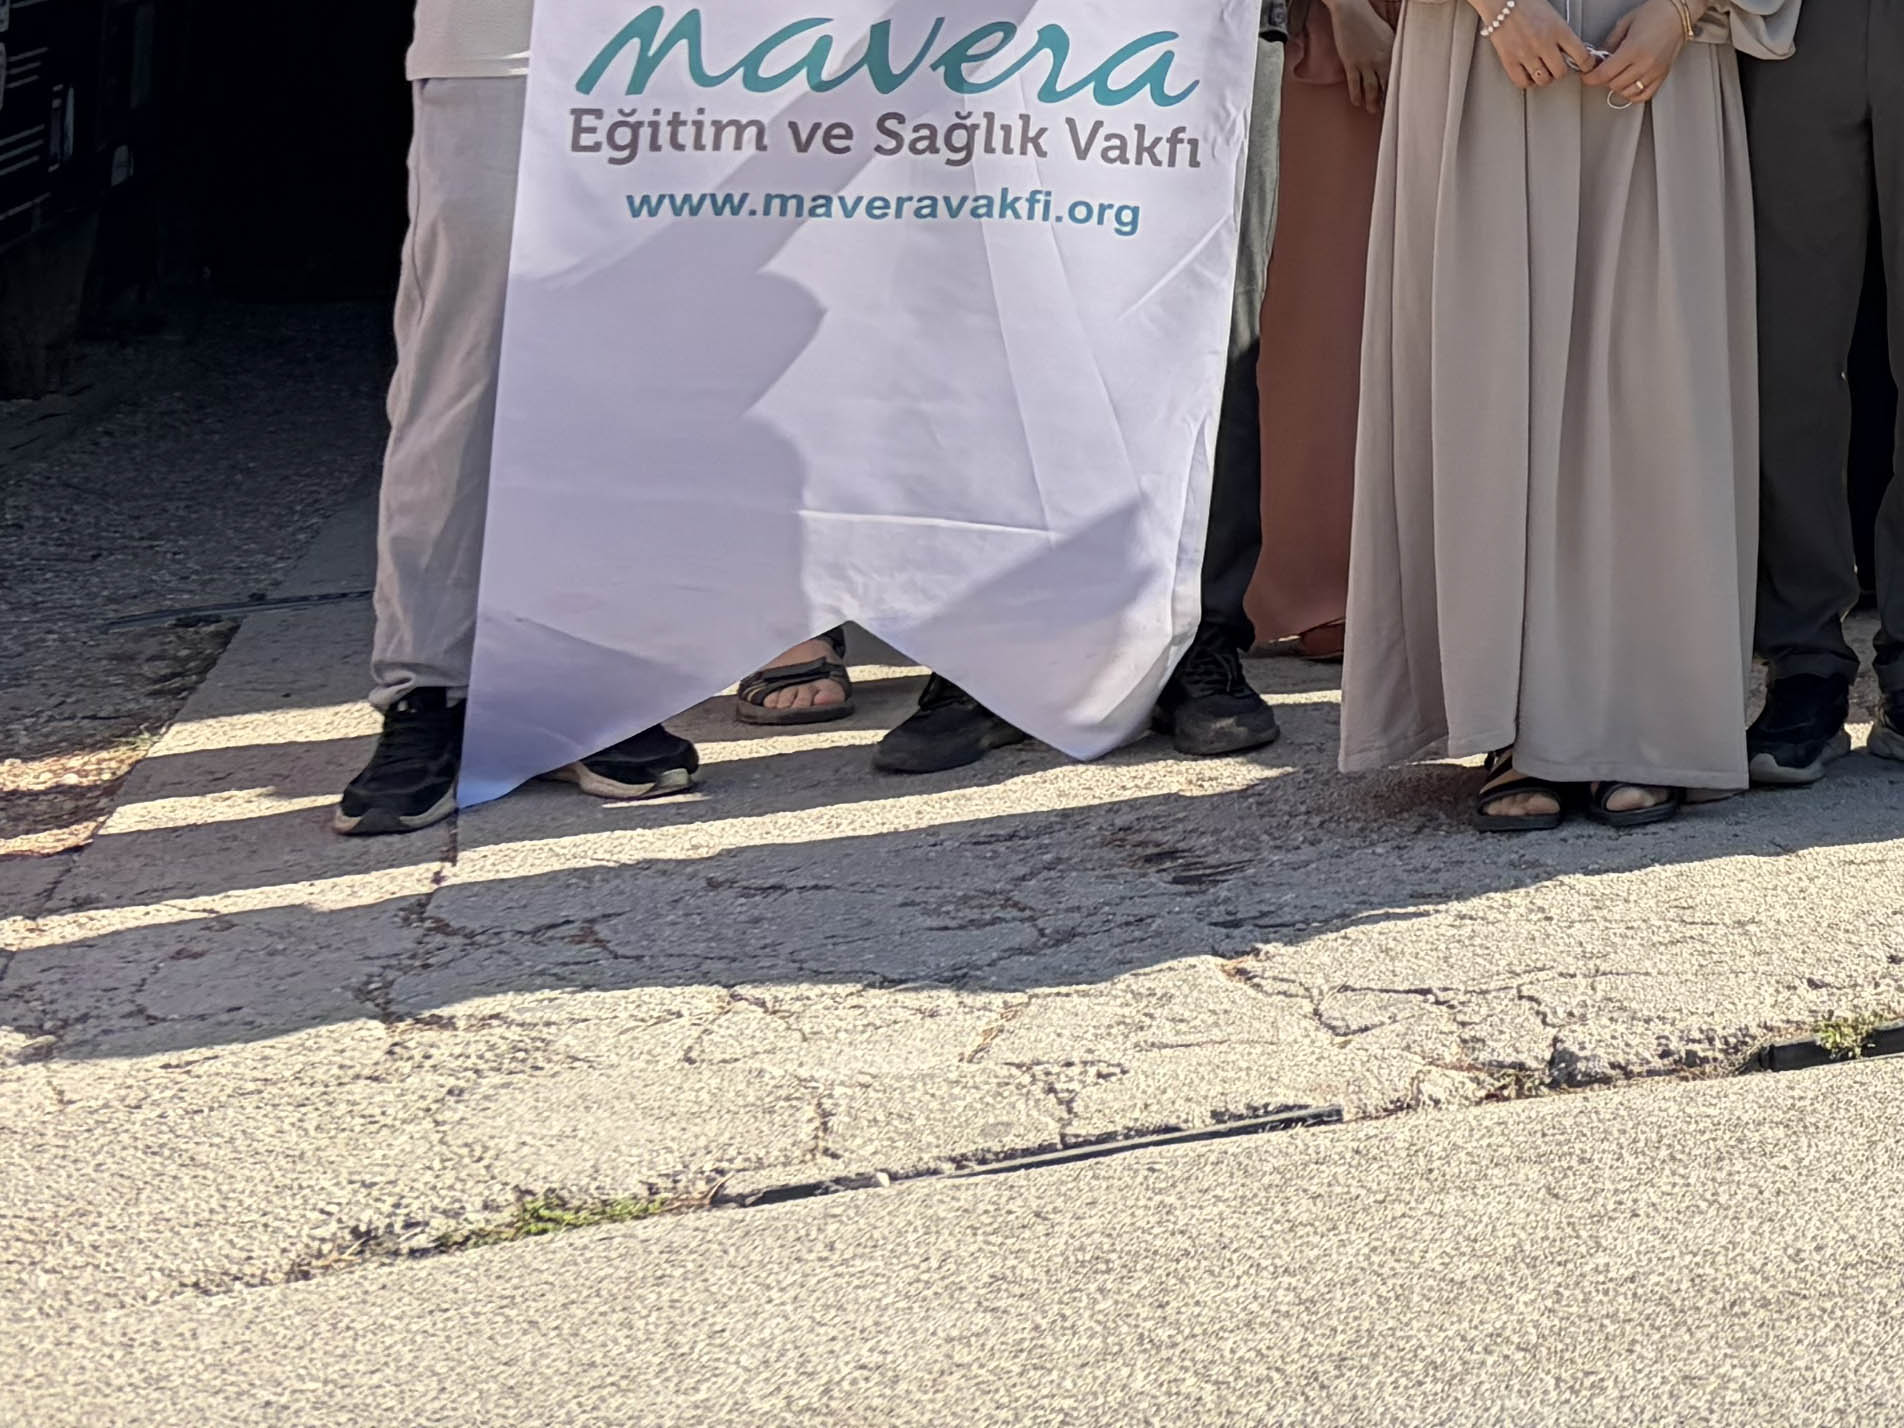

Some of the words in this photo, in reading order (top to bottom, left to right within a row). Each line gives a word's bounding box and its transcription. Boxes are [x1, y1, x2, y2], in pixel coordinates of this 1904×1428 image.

[569, 107, 768, 165] Eğitim
[788, 118, 855, 154] ve
[874, 110, 1048, 167] Sağlık
[1065, 116, 1201, 169] Vakfı
[626, 187, 1142, 236] www.maveravakfi.org
